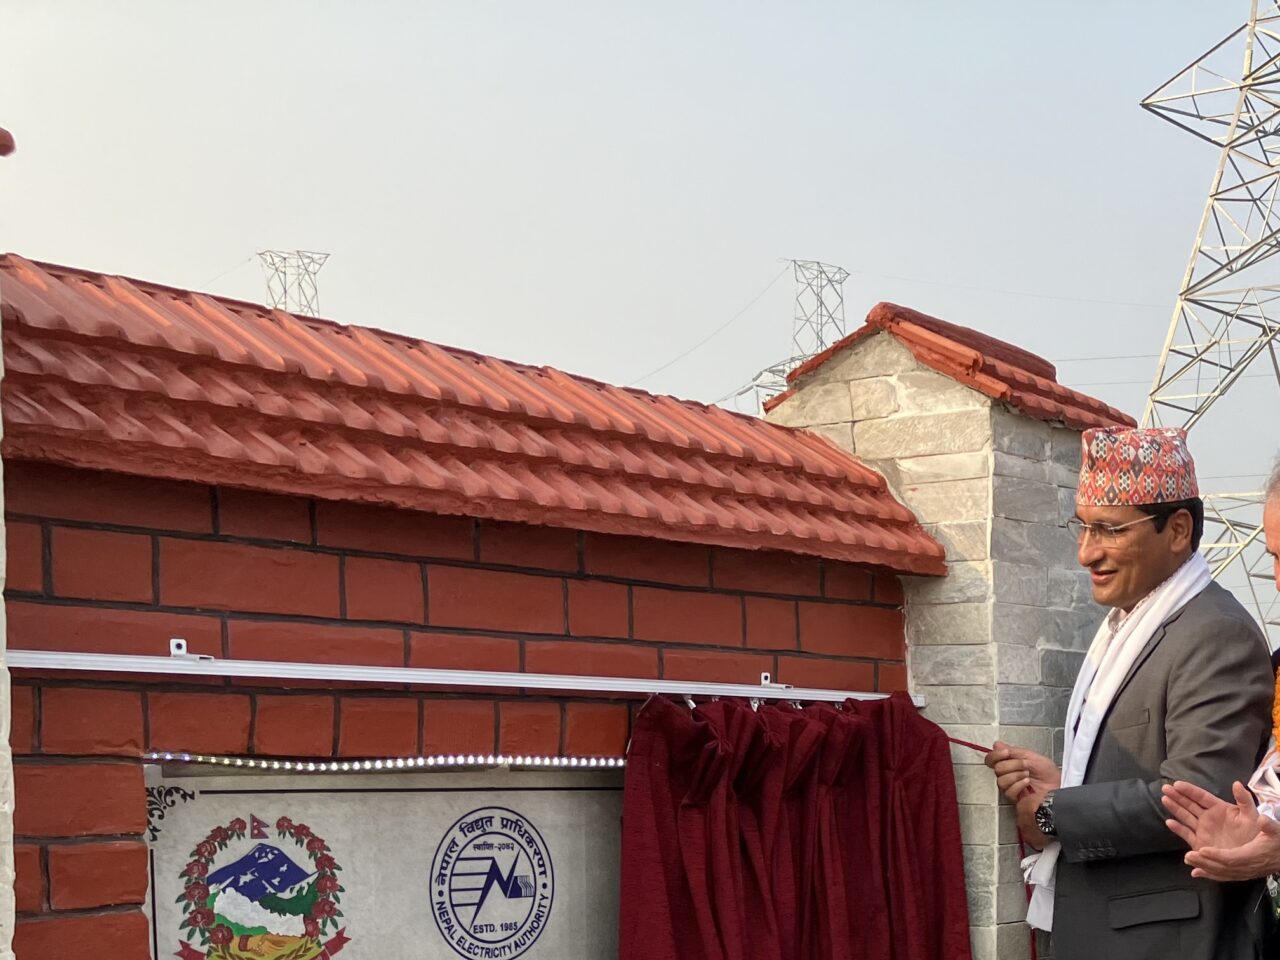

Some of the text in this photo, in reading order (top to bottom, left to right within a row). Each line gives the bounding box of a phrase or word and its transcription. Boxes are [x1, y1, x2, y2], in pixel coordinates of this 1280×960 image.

[435, 816, 547, 885] नेपाल विद्युत प्राधिकरण
[436, 894, 549, 958] NEPAL ELECTRICITY AUTHORITY
[473, 923, 497, 934] ESTD.
